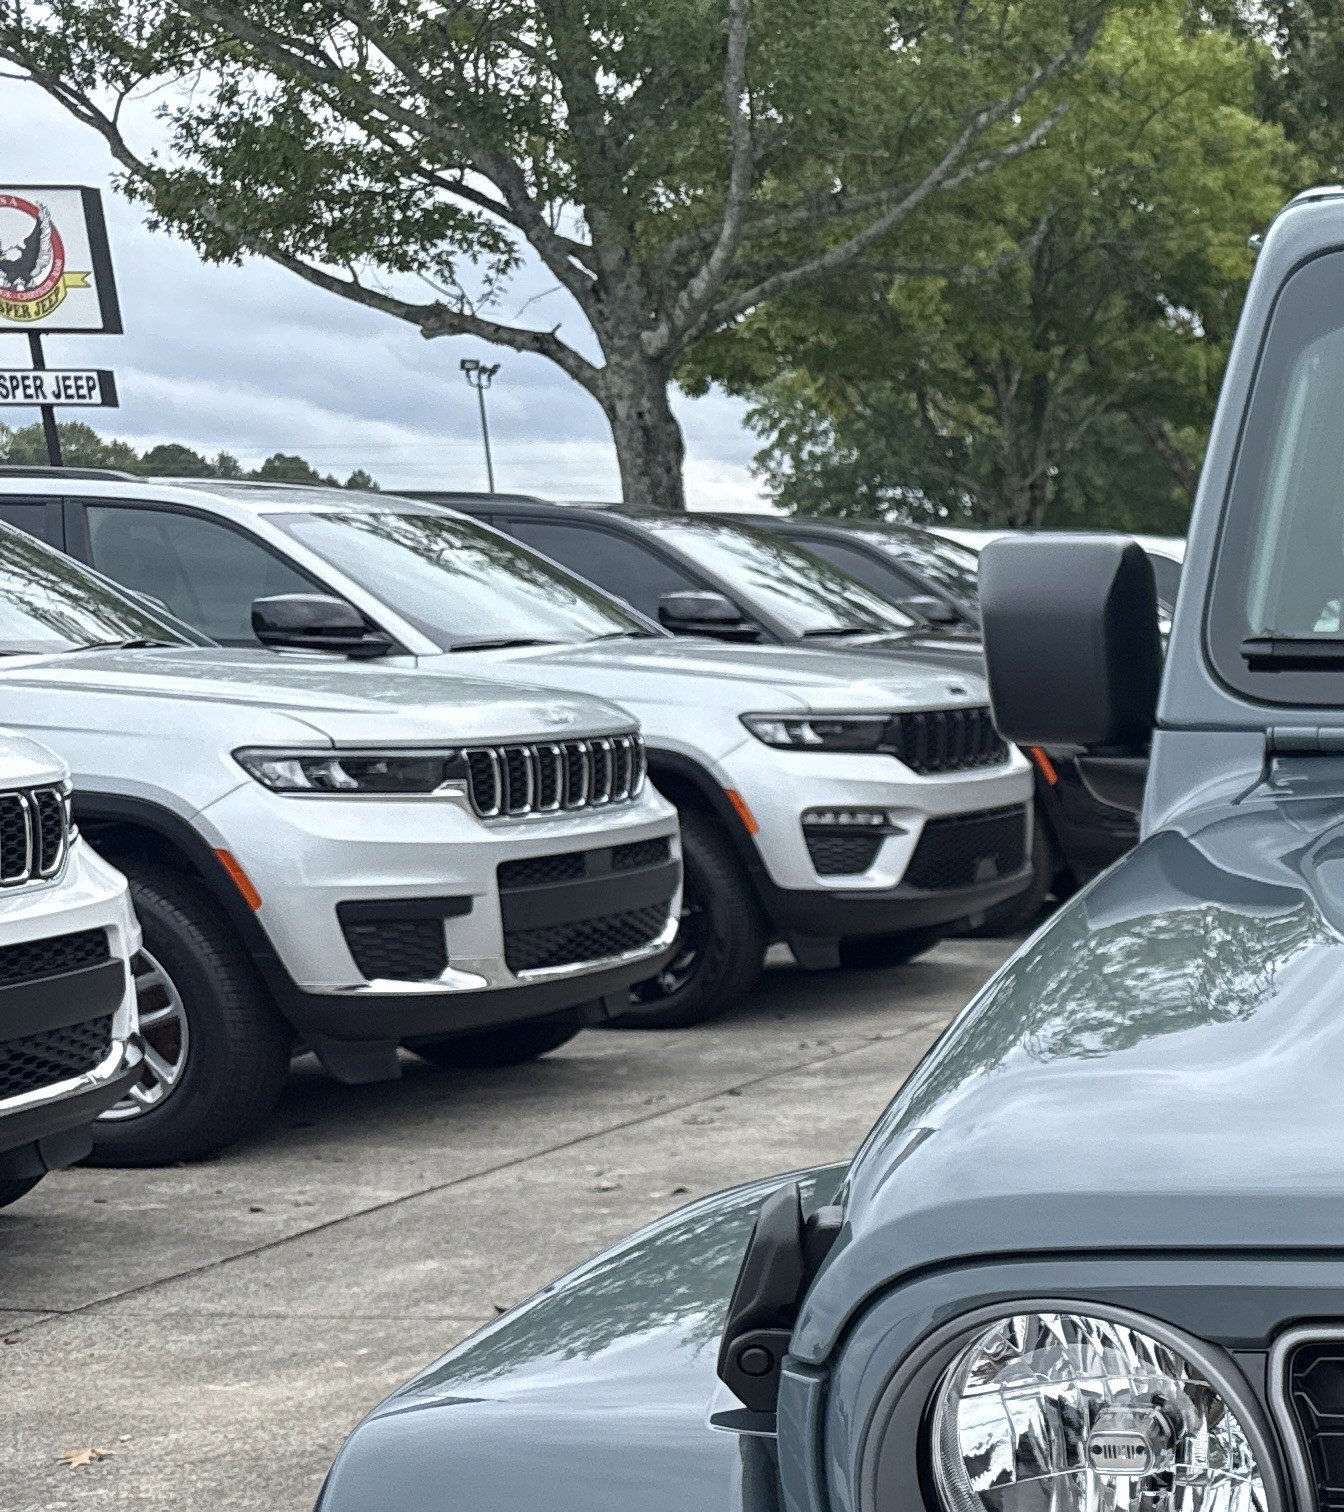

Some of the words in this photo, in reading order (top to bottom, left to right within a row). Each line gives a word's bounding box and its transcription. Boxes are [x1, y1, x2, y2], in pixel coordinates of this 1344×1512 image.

[34, 286, 60, 316] JEEP
[0, 375, 47, 399] SPER
[52, 375, 96, 400] JEEP
